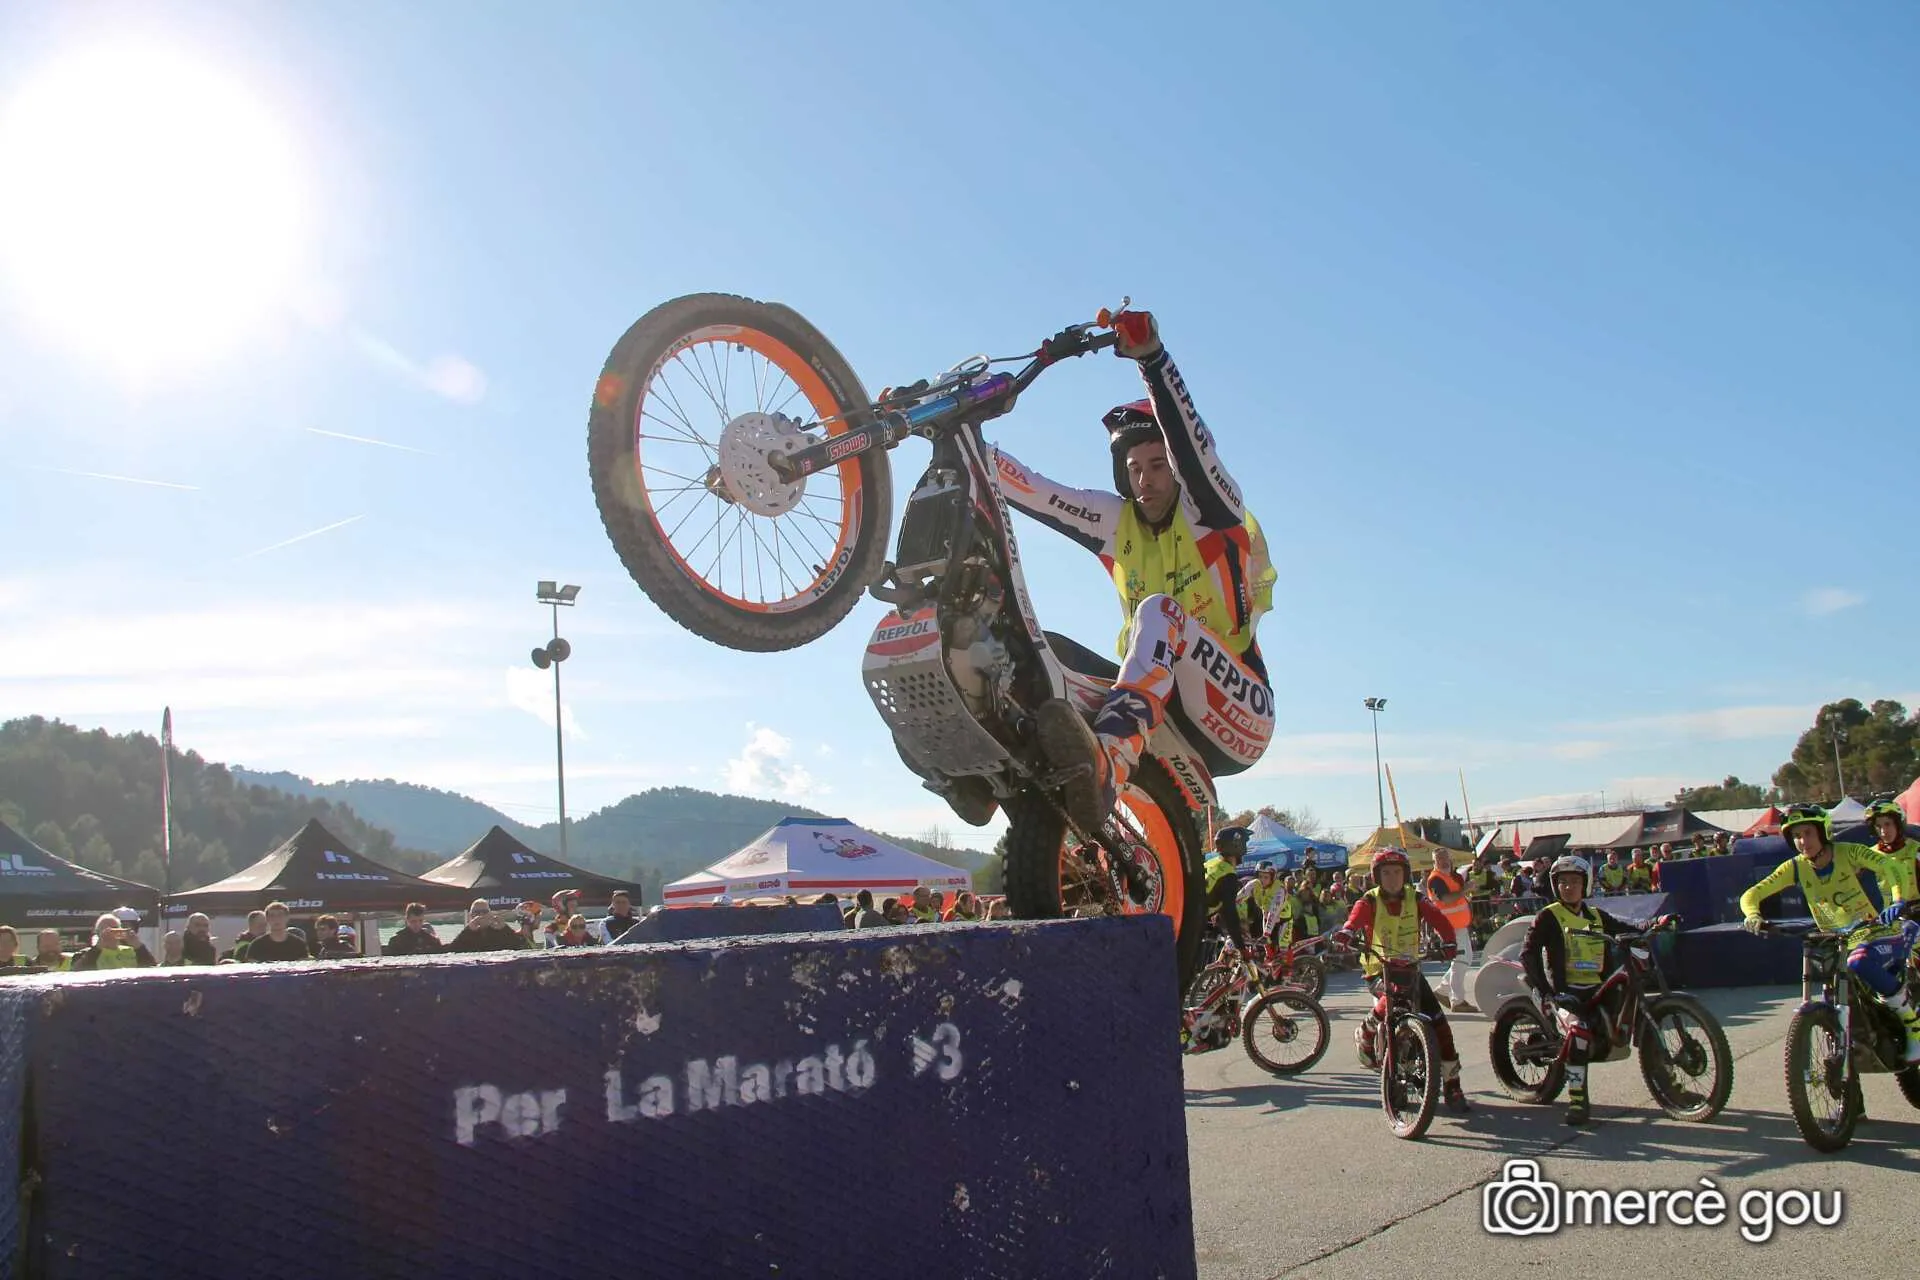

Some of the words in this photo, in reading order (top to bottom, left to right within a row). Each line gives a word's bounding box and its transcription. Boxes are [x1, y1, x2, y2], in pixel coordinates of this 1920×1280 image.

[1166, 364, 1210, 456] REPSOL
[830, 434, 866, 460] SHOWA
[1048, 493, 1102, 524] hebo
[1210, 464, 1242, 510] hebo
[876, 620, 929, 642] REPSOL
[1190, 636, 1274, 718] REPSOL
[1169, 754, 1209, 805] REPSOL
[315, 871, 390, 881] hebo
[453, 1083, 567, 1147] Per
[603, 1070, 675, 1123] La
[686, 1038, 876, 1112] Marató
